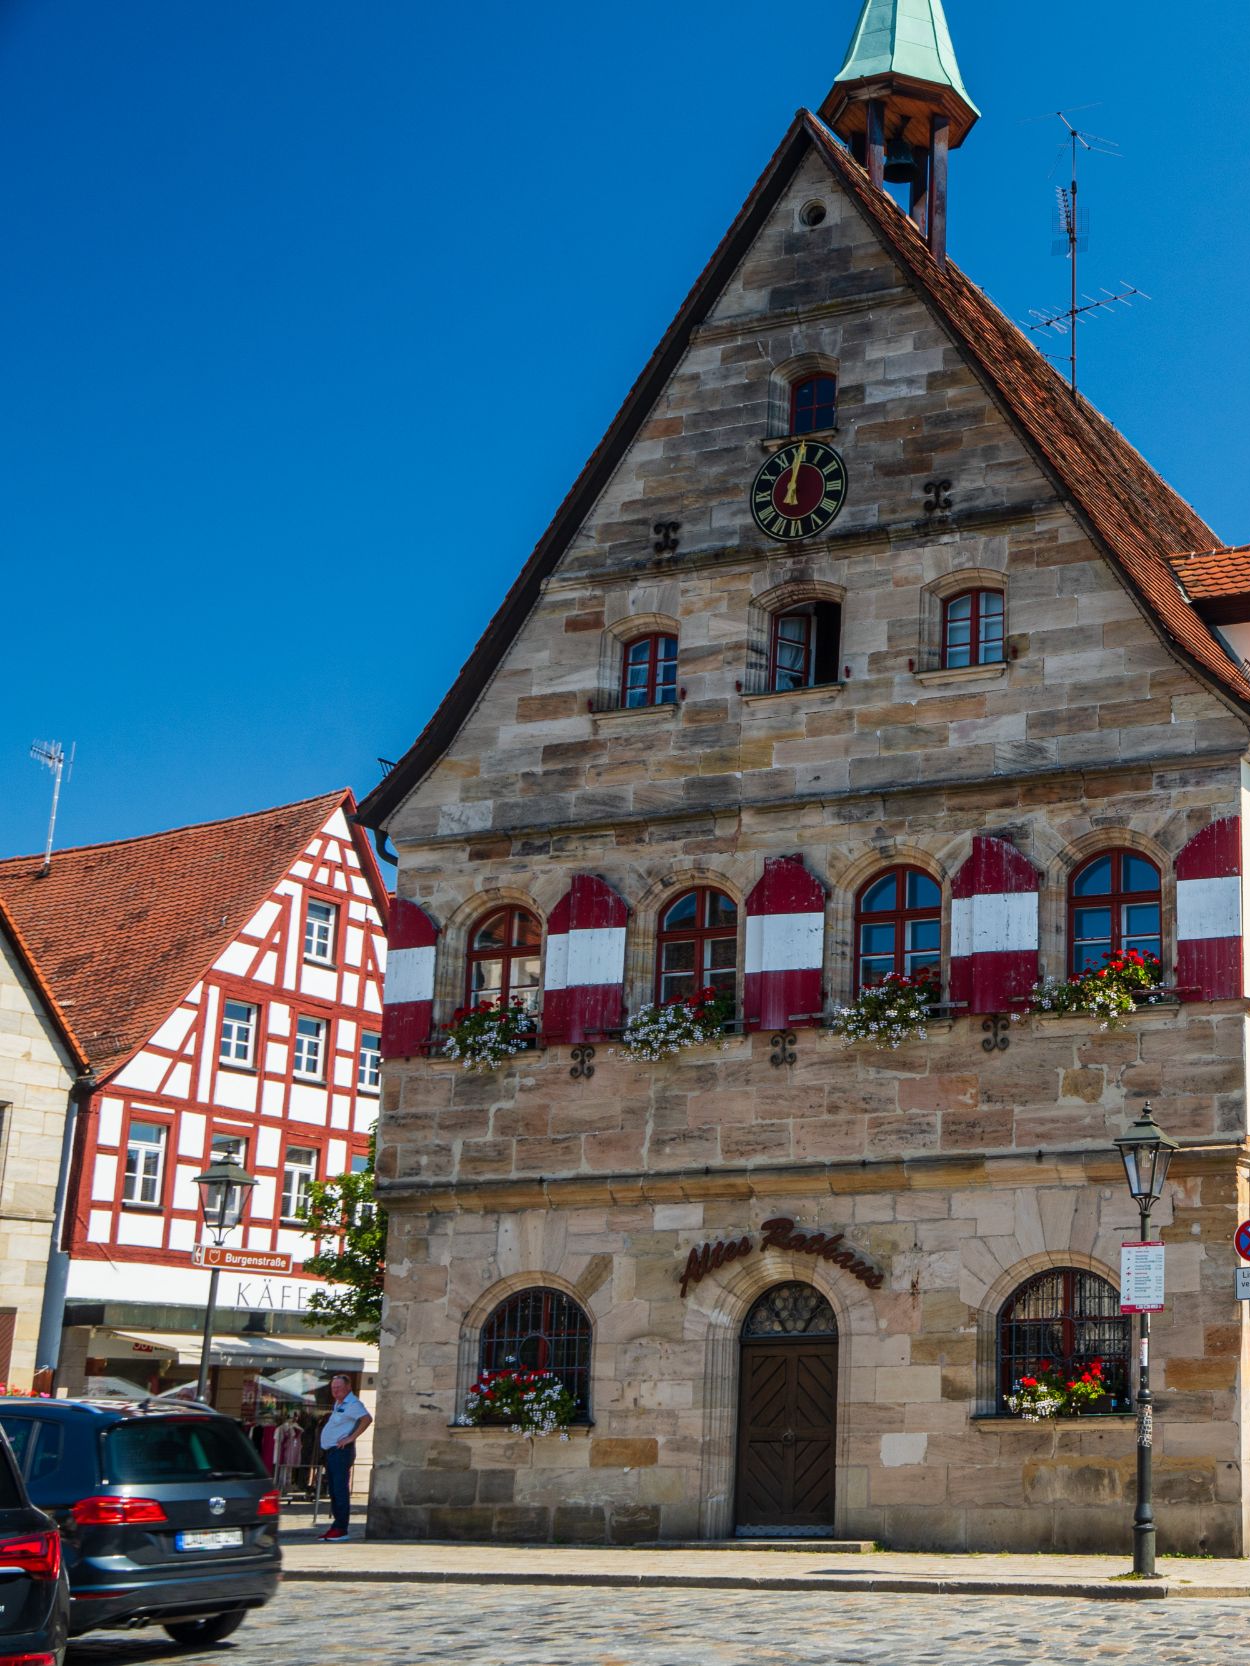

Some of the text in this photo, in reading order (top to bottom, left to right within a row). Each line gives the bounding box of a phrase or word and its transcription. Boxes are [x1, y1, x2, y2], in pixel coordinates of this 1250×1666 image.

[760, 470, 777, 483] X
[224, 1252, 287, 1269] Burgenstraße
[679, 1217, 885, 1298] Altes Rathaus
